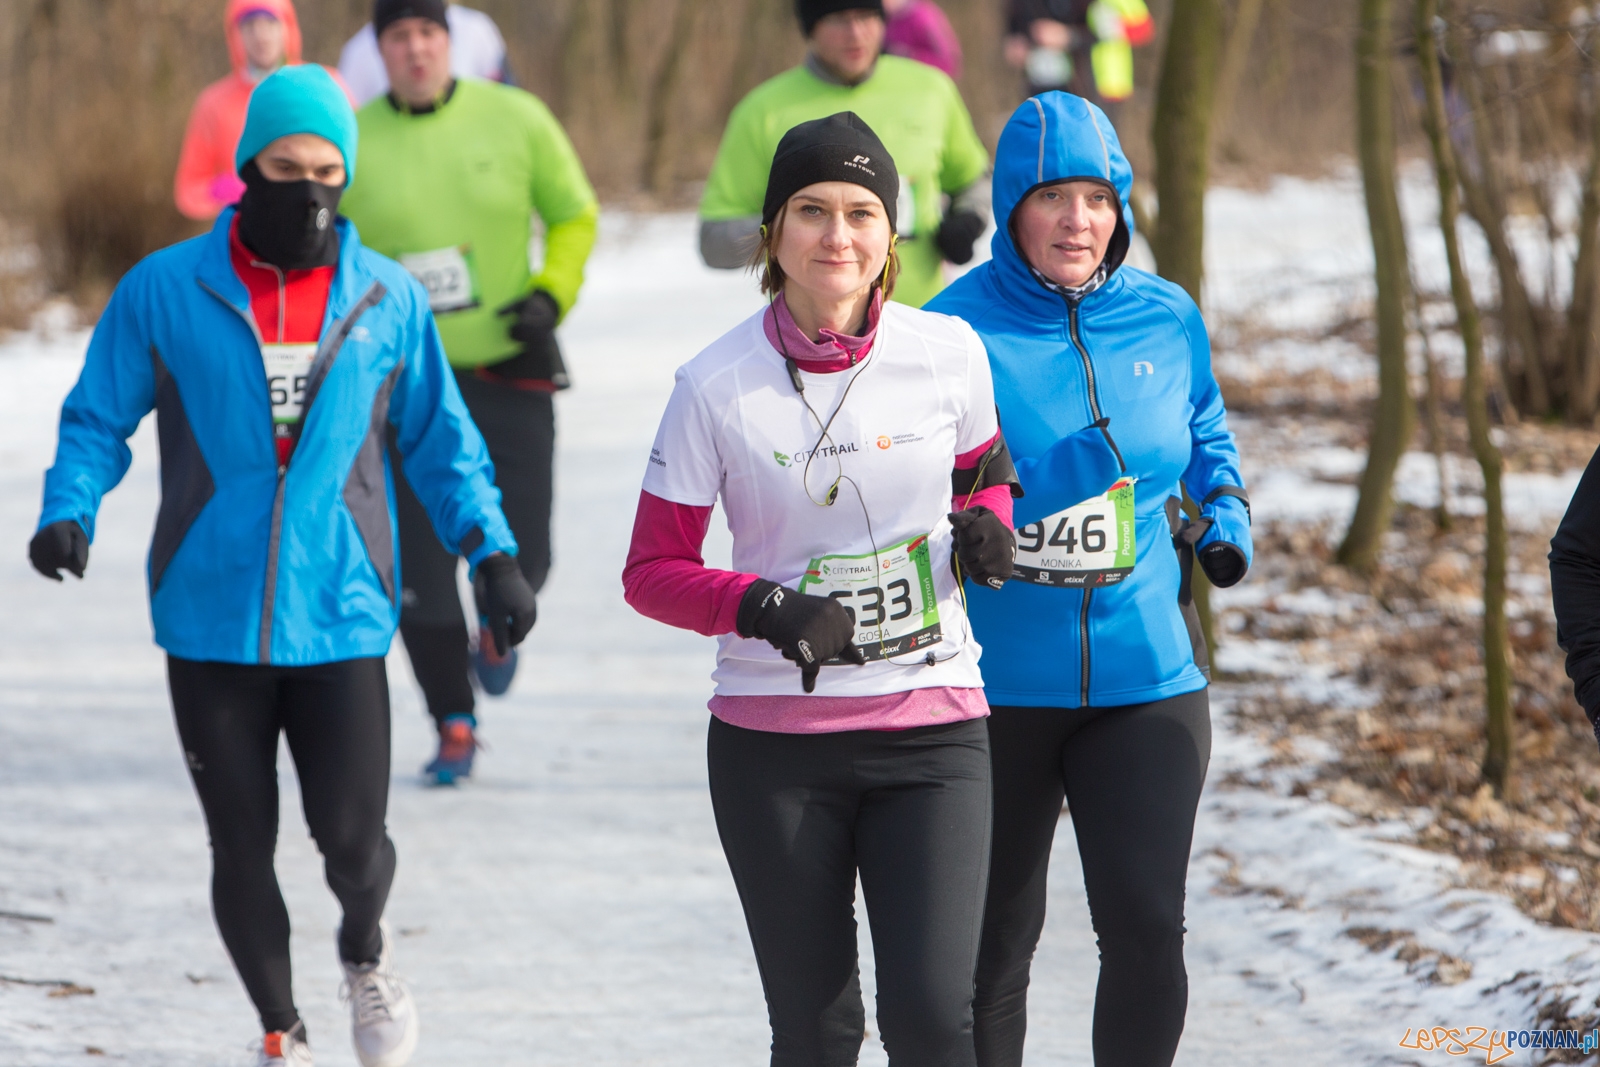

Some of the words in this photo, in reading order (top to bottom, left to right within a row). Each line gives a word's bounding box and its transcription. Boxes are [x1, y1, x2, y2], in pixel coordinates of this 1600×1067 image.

[1017, 514, 1106, 554] 946
[1121, 520, 1131, 556] Poznań
[1040, 558, 1083, 568] MONIKA
[923, 576, 935, 614] Poznań
[858, 628, 891, 643] GOSIA
